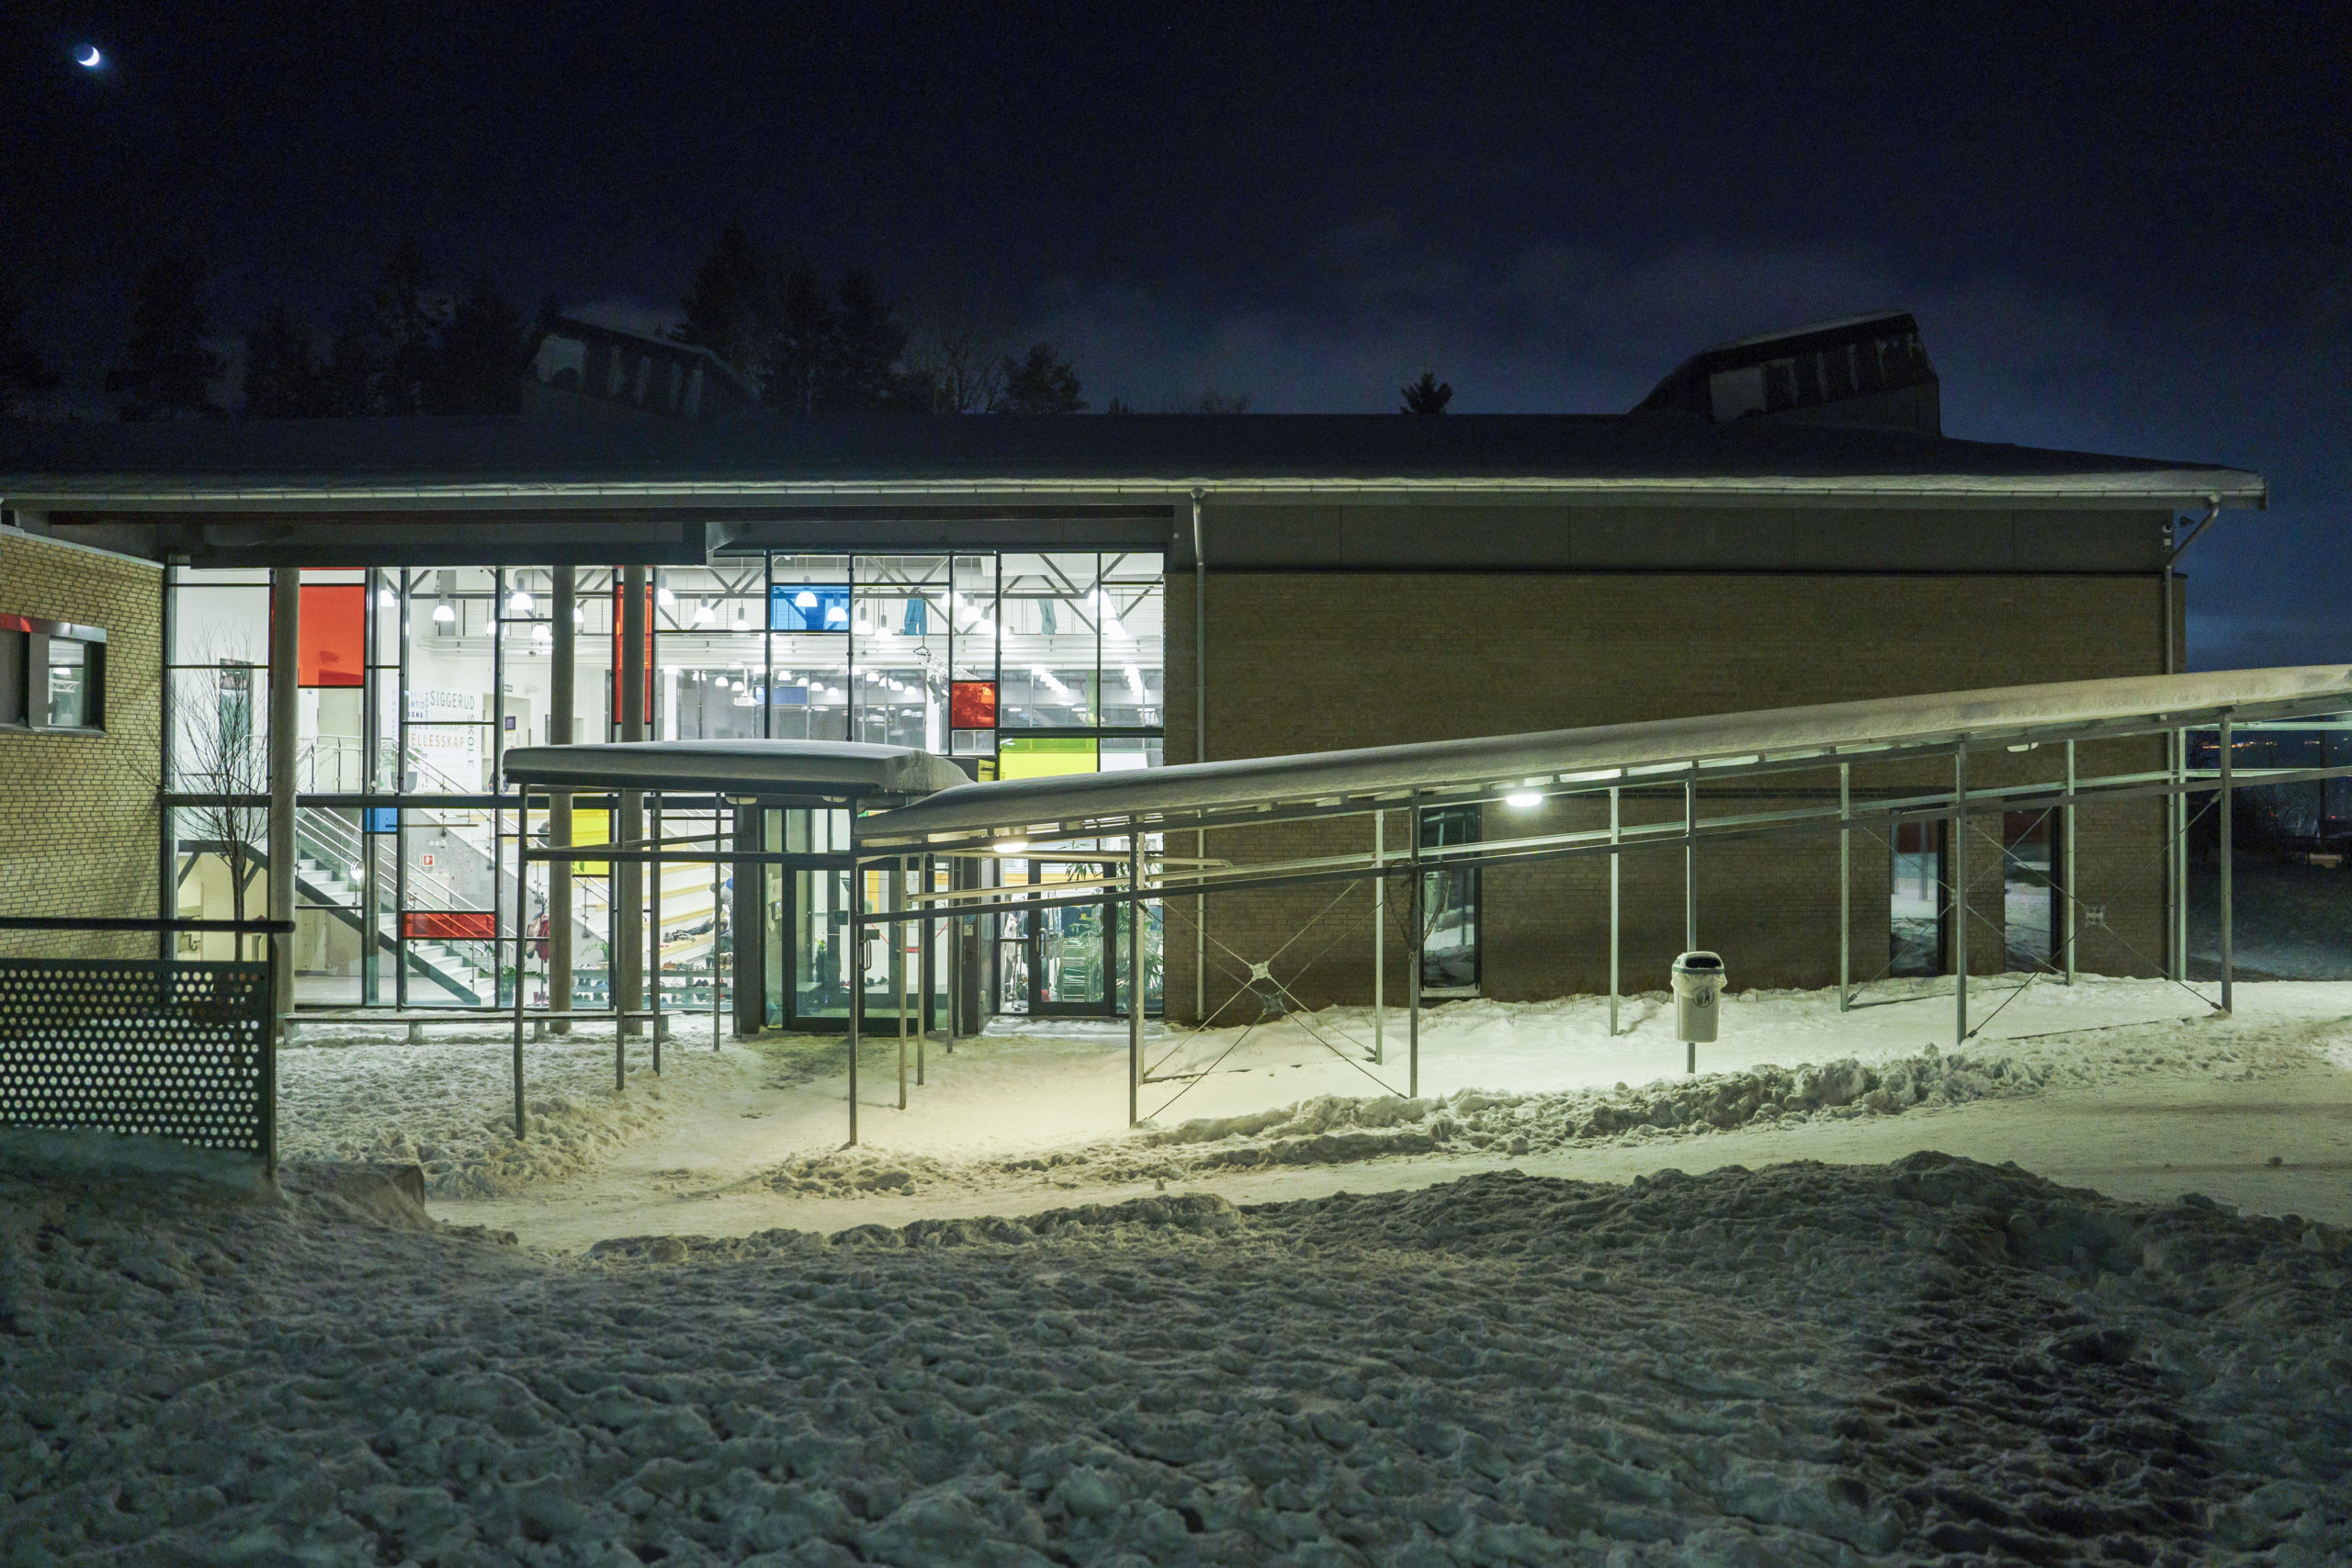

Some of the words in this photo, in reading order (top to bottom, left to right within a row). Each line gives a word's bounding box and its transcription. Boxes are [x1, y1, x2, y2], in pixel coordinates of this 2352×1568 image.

[430, 690, 475, 710] SIGGERUD
[411, 733, 465, 749] ELLESSKAP
[467, 714, 475, 769] SKOLE
